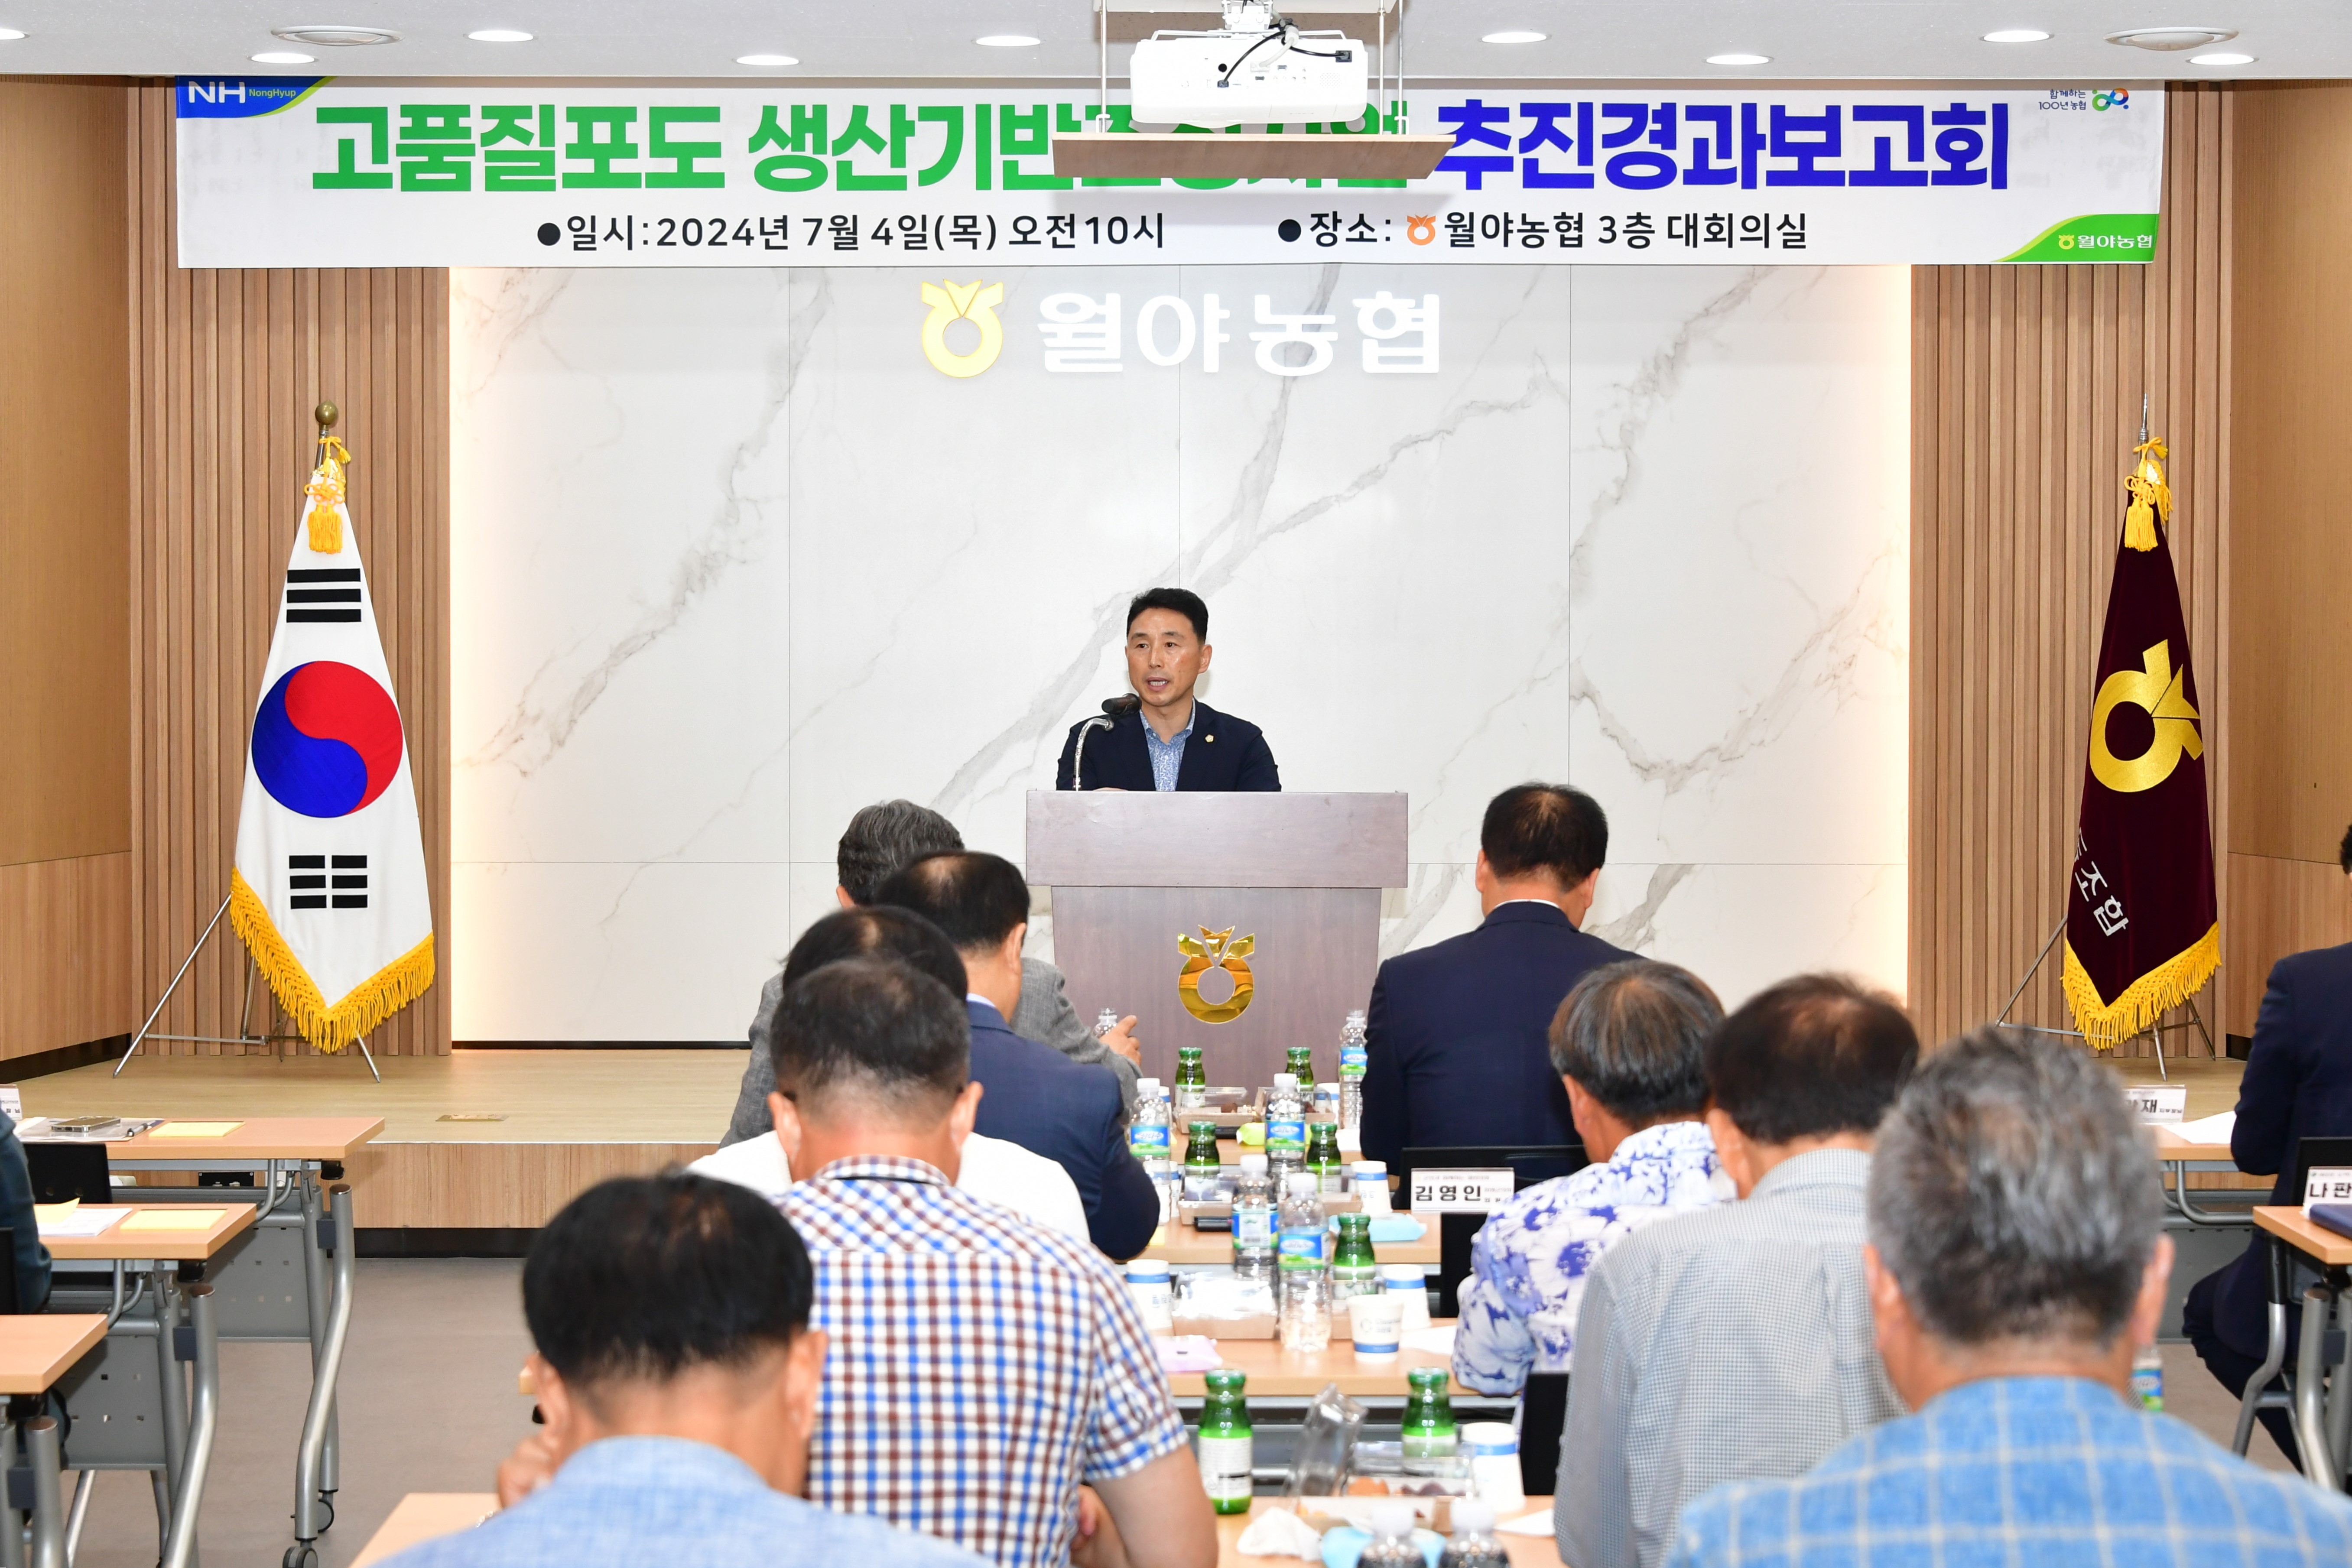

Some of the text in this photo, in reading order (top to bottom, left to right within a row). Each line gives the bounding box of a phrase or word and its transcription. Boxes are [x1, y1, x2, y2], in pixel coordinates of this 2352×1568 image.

[188, 81, 246, 104] NH
[249, 88, 296, 98] NongHyup
[2050, 89, 2086, 99] 함께하는
[2038, 100, 2086, 110] 100년 농협
[313, 99, 2008, 192] 고품질포도 생산기반 추진경과보고회
[803, 214, 858, 250] 7월
[871, 214, 996, 250] 4일(목)
[1310, 211, 1806, 249] 장소: 월야농협 3층 대회의실
[2078, 234, 2152, 249] 월야농협
[1037, 291, 1439, 376] 월야농협
